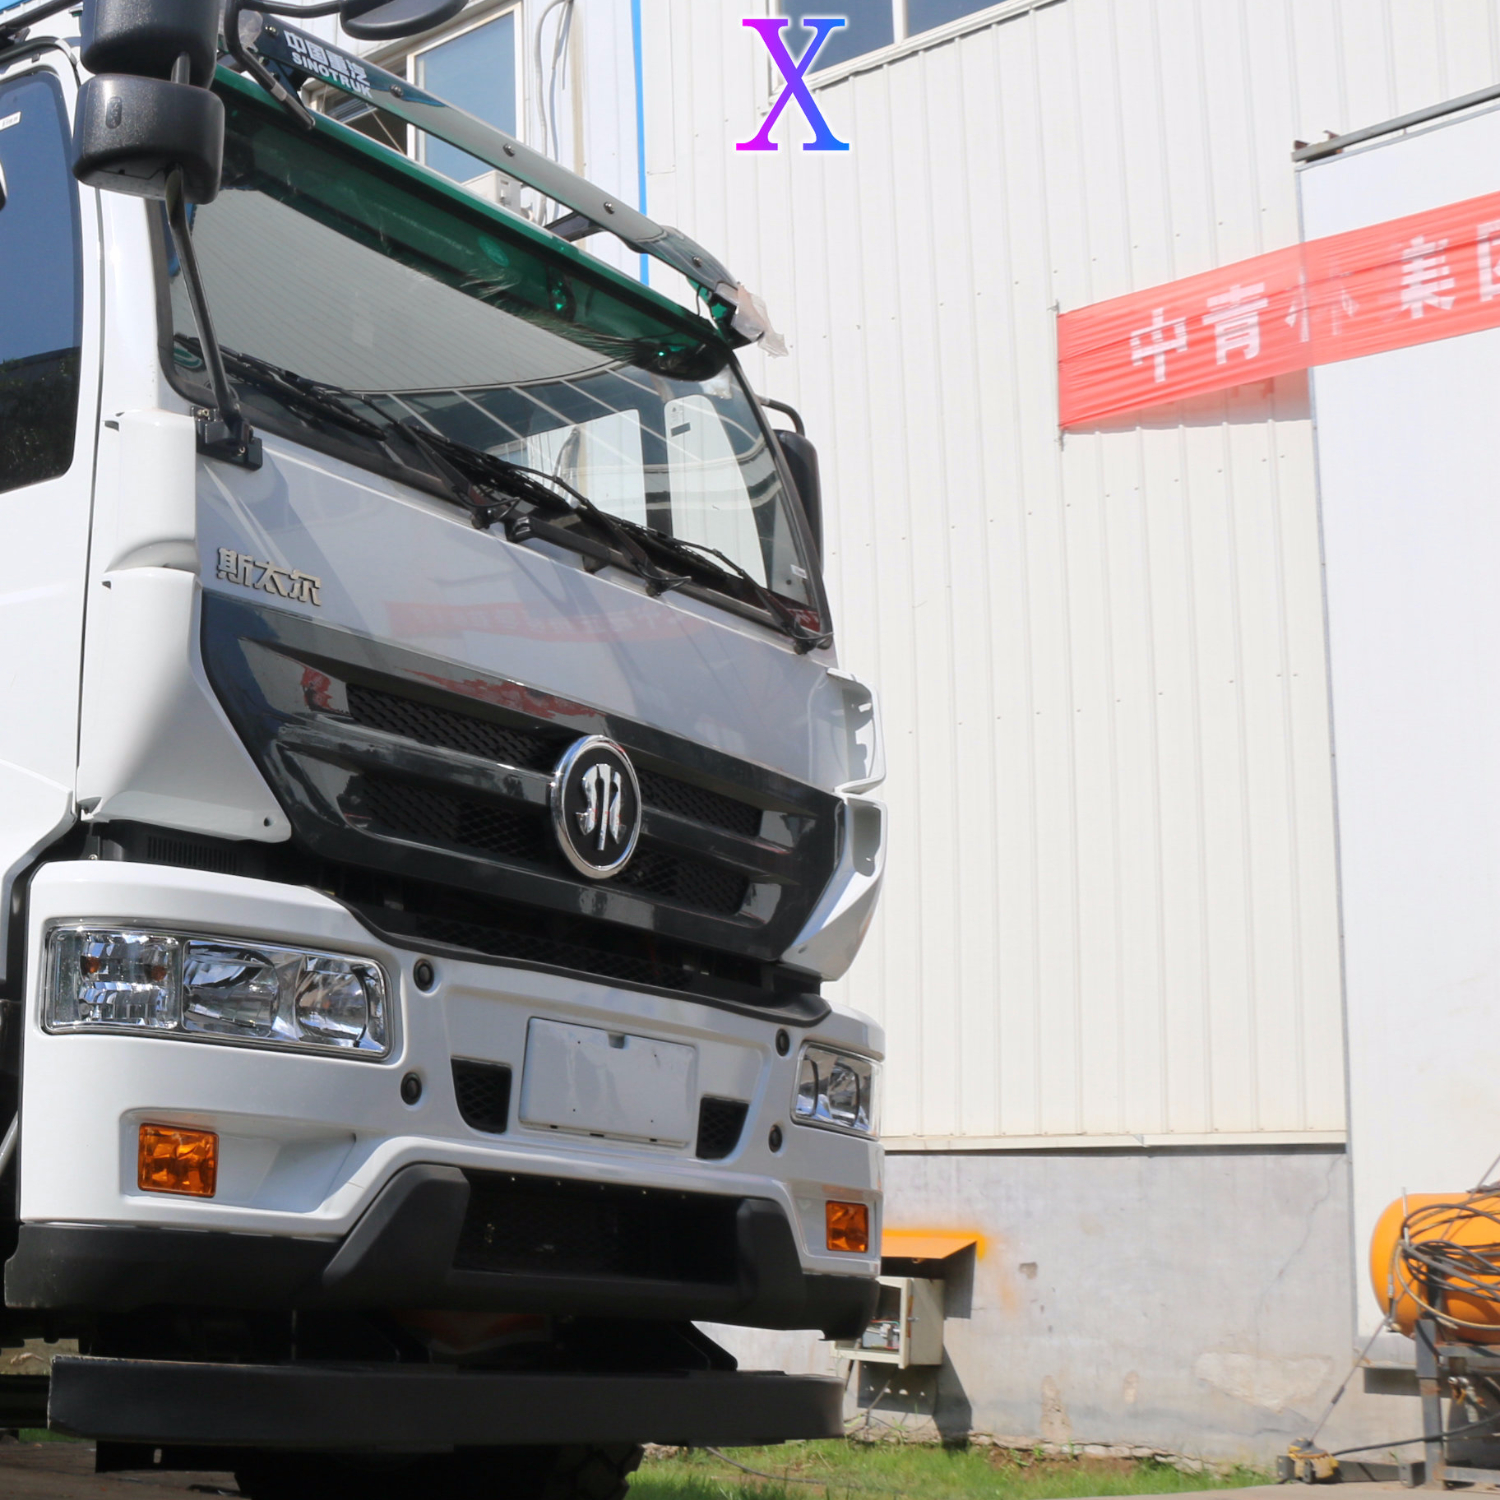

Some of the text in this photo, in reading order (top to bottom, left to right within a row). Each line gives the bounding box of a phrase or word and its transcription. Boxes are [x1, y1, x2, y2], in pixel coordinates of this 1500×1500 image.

[283, 30, 370, 87] 中国重汽
[291, 51, 373, 99] SINOTRUK
[217, 548, 321, 606] 斯太尔
